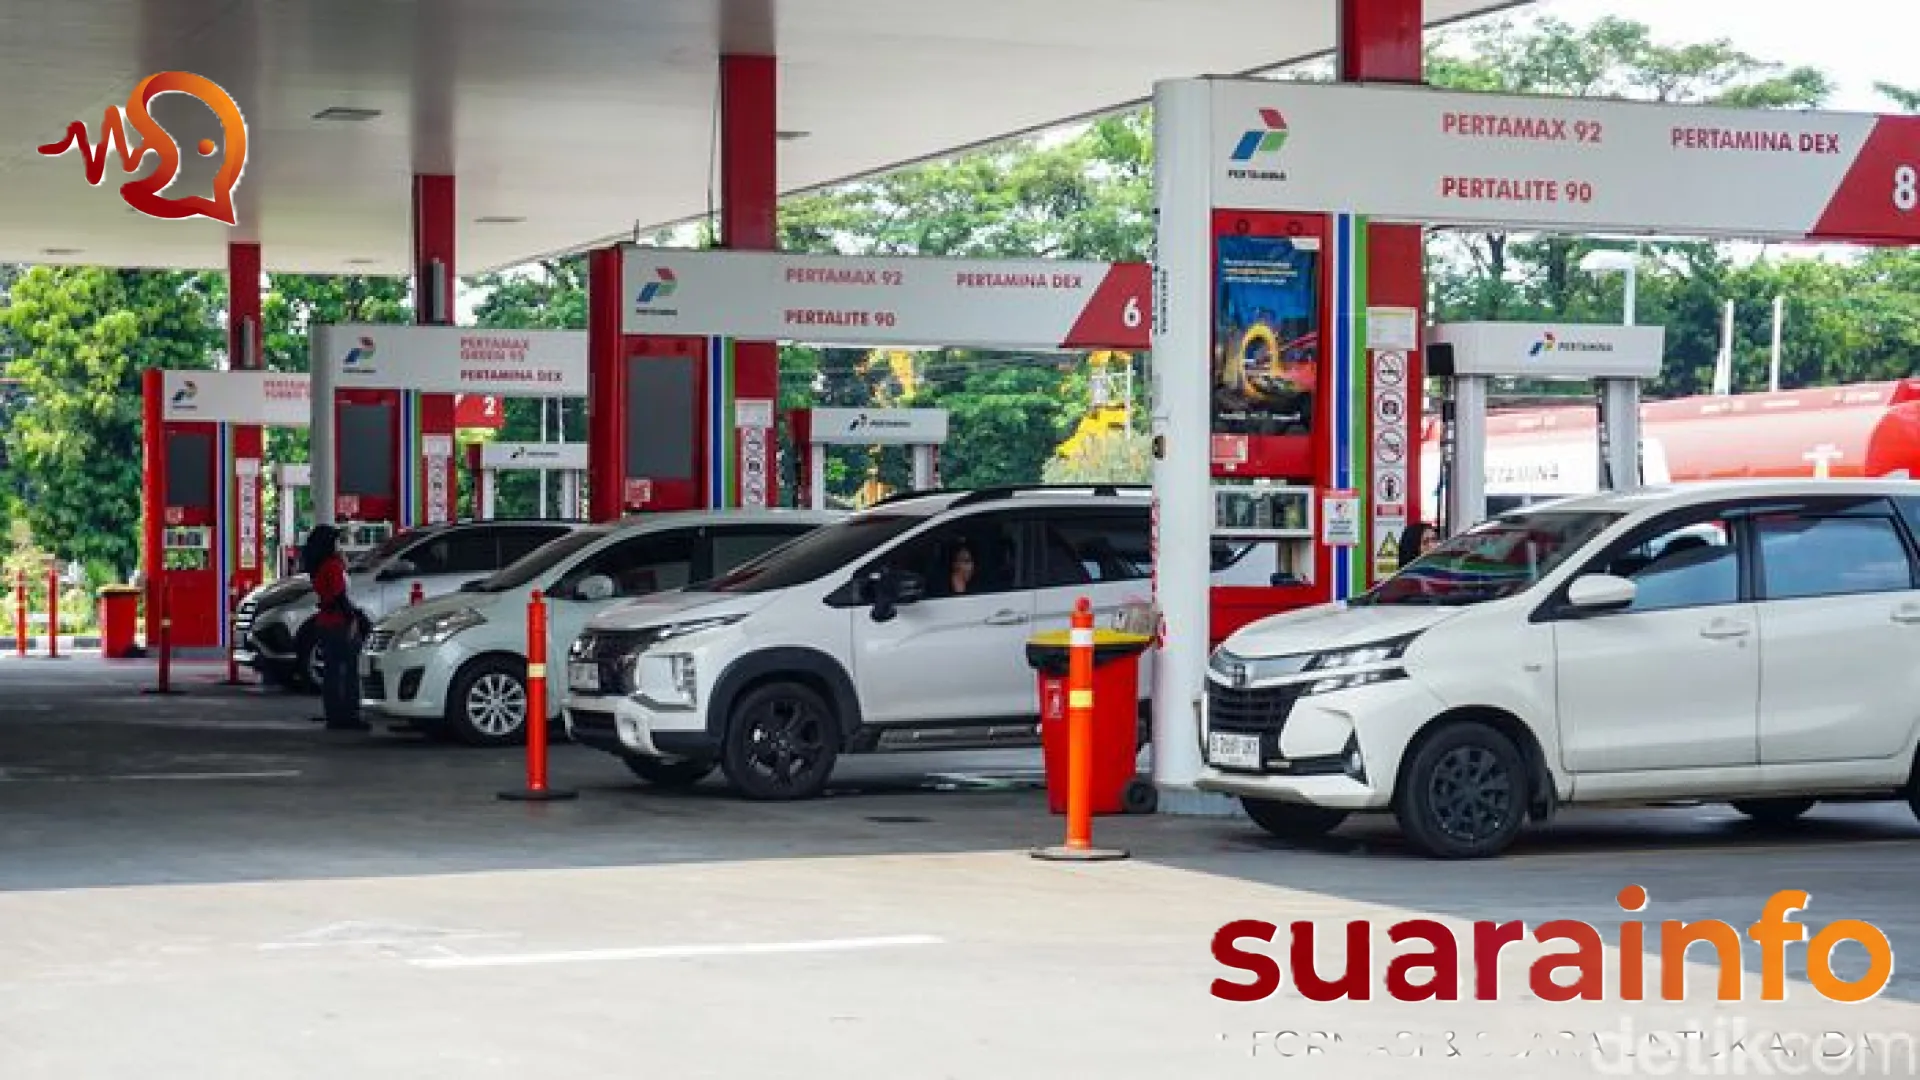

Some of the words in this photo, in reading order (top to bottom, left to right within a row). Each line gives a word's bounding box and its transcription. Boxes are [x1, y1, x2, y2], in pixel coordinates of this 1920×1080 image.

[1442, 112, 1567, 140] PERTAMAX
[1573, 120, 1603, 143] 92
[1670, 128, 1793, 152] PERTAMINA
[1798, 133, 1841, 154] DEX
[1442, 176, 1559, 201] PERTALITE
[1565, 181, 1593, 204] 90
[1893, 164, 1918, 211] 8
[785, 268, 877, 284] PERTAMAX
[881, 270, 904, 285] 92
[956, 273, 1046, 288] PERTAMINA
[1052, 274, 1082, 289] DEX
[785, 309, 869, 326] PERTALITE
[874, 311, 896, 327] 90
[1123, 296, 1142, 328] 6
[460, 369, 533, 382] PERTAMINA
[537, 371, 563, 383] DEX
[484, 395, 497, 416] 2
